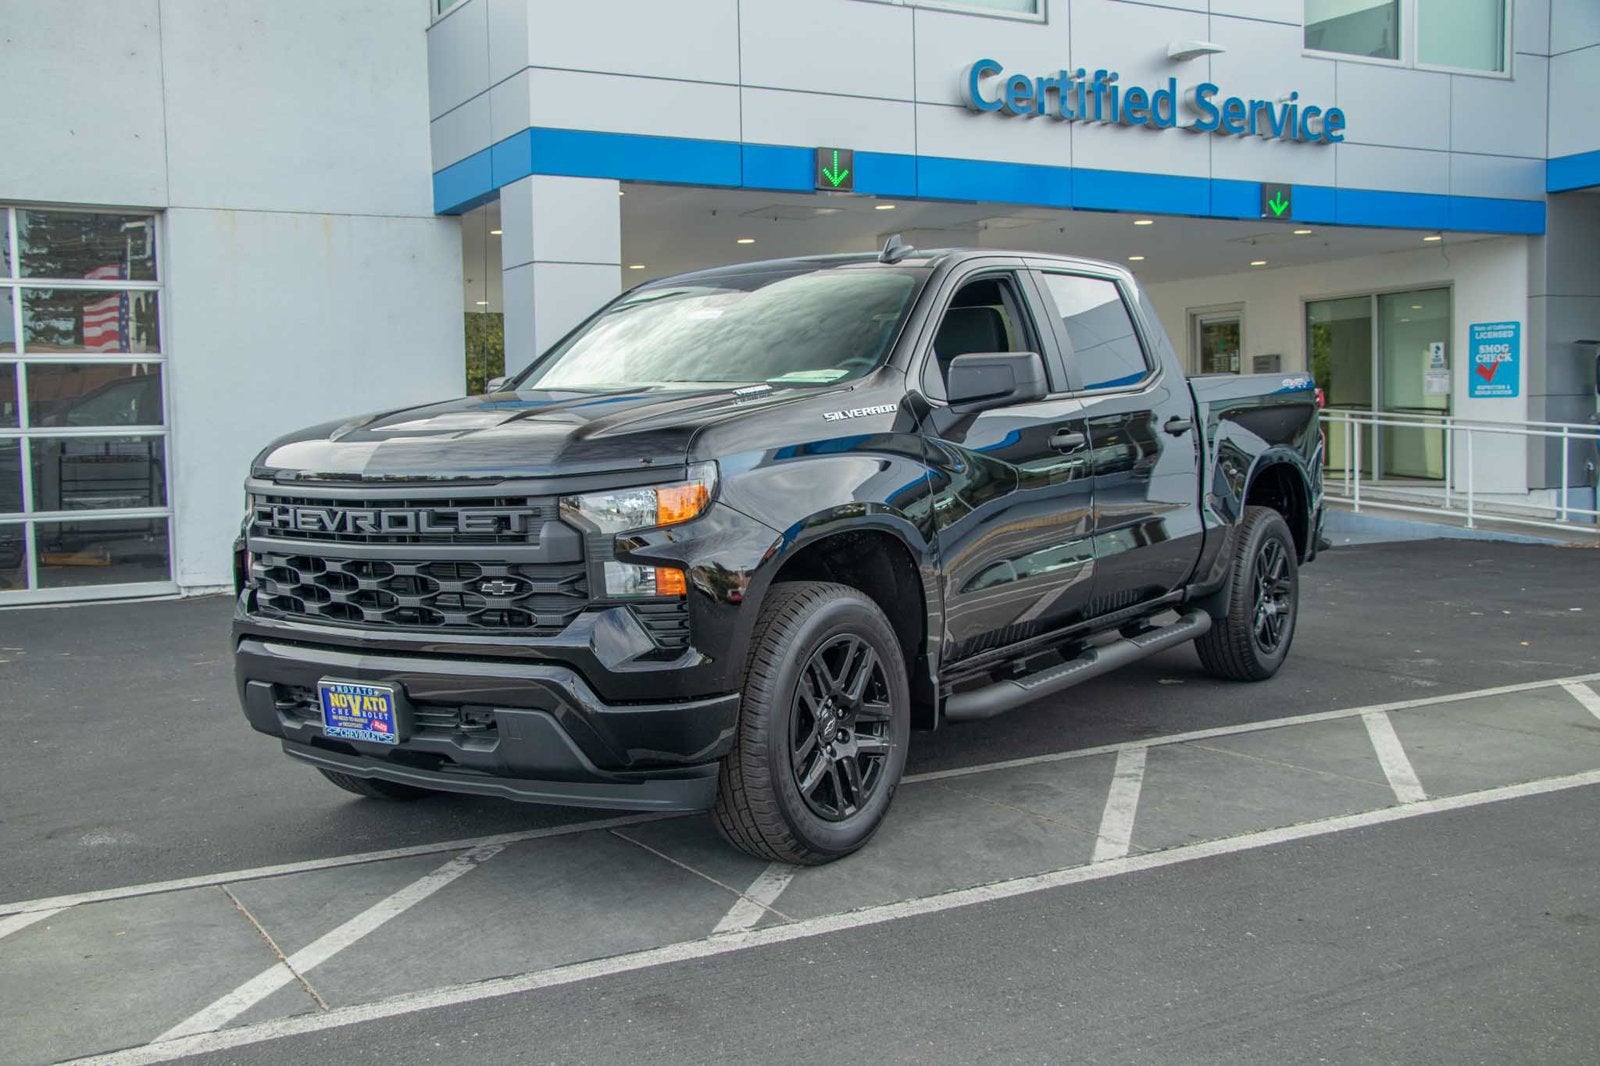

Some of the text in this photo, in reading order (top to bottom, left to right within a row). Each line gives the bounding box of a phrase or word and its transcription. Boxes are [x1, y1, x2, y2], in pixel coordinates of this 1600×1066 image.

[969, 58, 1346, 143] Certified Service
[1475, 330, 1514, 340] LICENSED
[1479, 343, 1510, 354] SMOG
[1475, 352, 1513, 363] CHECK
[823, 403, 898, 422] SILVERADO
[253, 504, 541, 535] CHEVROLET
[336, 685, 374, 696] NOVATO
[329, 692, 388, 716] NOVATO
[340, 728, 380, 741] CHEVROLET
